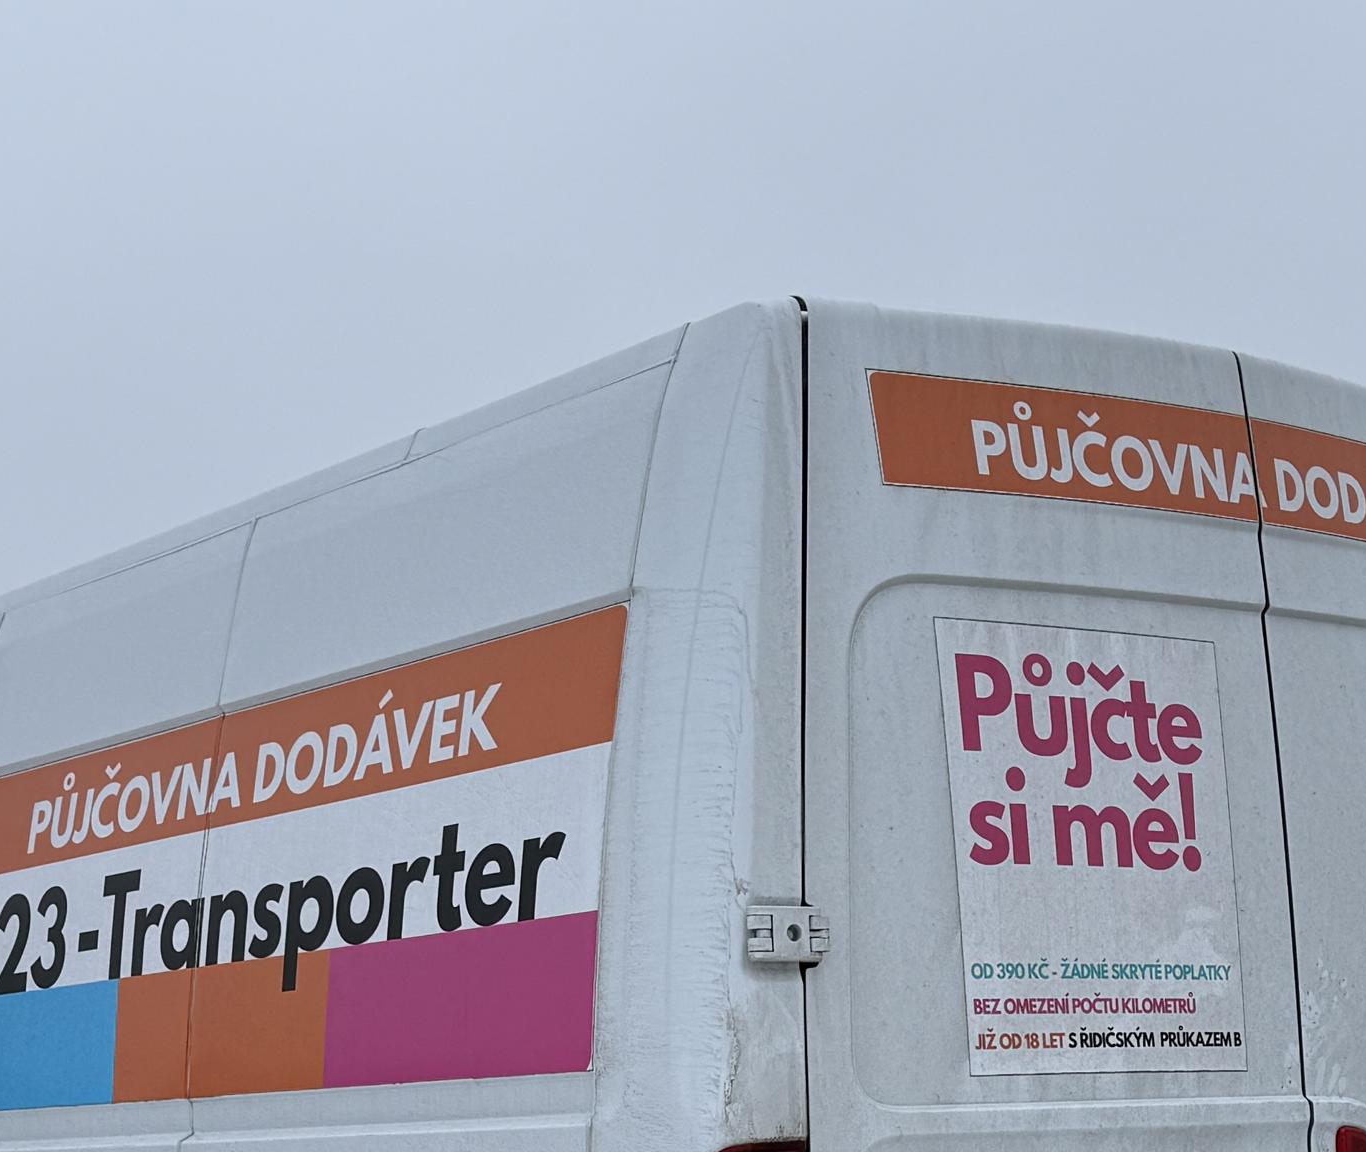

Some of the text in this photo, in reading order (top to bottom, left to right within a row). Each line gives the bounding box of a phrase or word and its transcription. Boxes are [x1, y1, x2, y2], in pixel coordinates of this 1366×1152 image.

[970, 401, 1267, 508] PŮJČOVNA
[26, 682, 502, 854] PŮJČOVNA DODÁVEK
[954, 652, 1203, 788] Půjčte
[969, 766, 1202, 872] si mě!
[971, 963, 994, 980] OD
[996, 963, 1025, 980] 390
[1027, 958, 1049, 980] KČ
[1060, 958, 1109, 980] ŽÁDNÉ
[1111, 960, 1162, 980] SKRYTÉ
[1165, 964, 1231, 981] POPLATKY
[973, 991, 1197, 1015] BEZ OMEZENÍ POČTU KILOMETRŮ
[975, 1025, 1242, 1050] JIŽ OD 18 LET S ŘIDIČSKÝM PRŮKAZEM B
